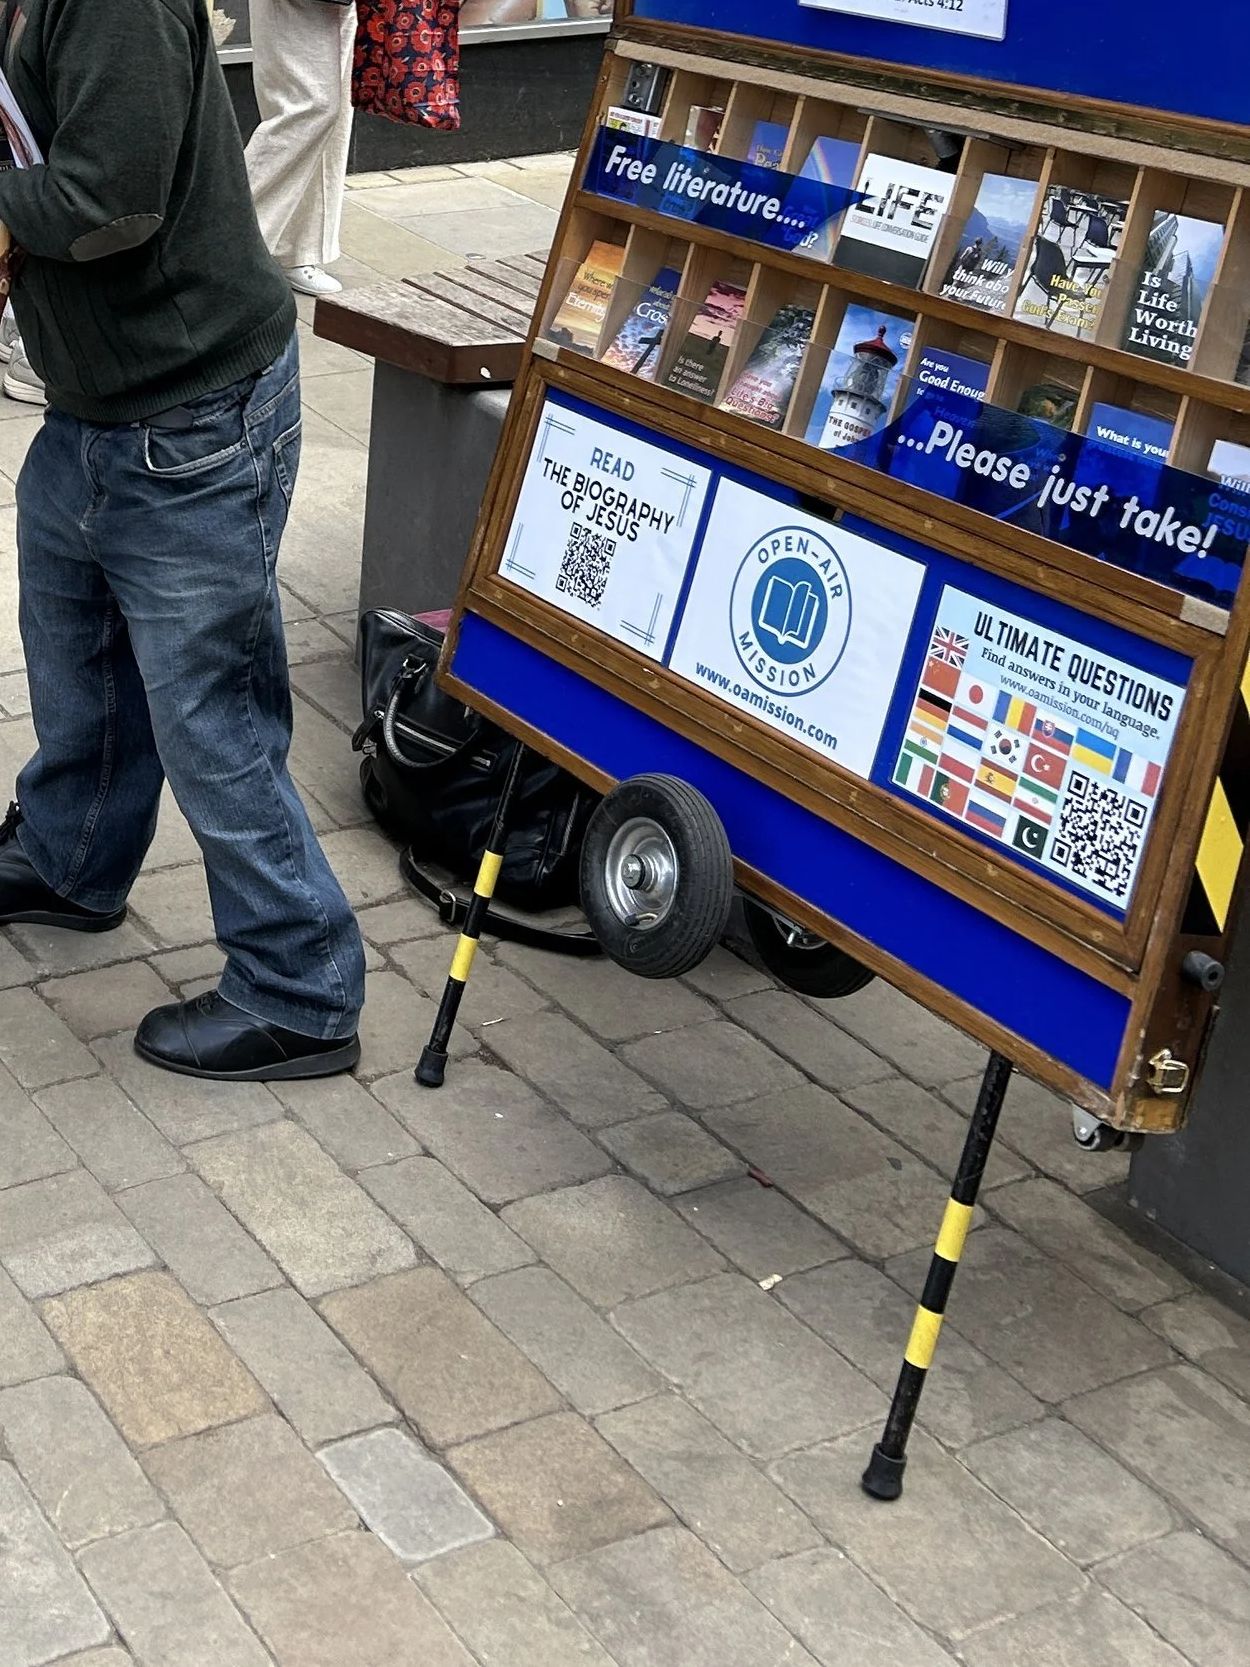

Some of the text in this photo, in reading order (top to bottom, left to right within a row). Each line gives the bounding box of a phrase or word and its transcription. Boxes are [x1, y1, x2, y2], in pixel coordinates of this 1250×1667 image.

[605, 145, 657, 185] Free
[855, 178, 945, 231] LIFE
[584, 270, 608, 288] Where
[952, 268, 982, 289] think
[981, 259, 1006, 276] Will
[1141, 270, 1161, 288] Is
[577, 284, 594, 298] you
[939, 283, 970, 299] your
[1051, 274, 1079, 292] Have
[565, 291, 607, 323] Eternity
[1137, 289, 1178, 313] Life
[1135, 308, 1198, 338] Worth
[1128, 327, 1193, 361] Living
[672, 366, 708, 383] an answer
[684, 358, 705, 372] there
[920, 358, 949, 374] Are you
[668, 374, 677, 382] to
[919, 370, 950, 390] Good
[757, 397, 775, 412] Big
[829, 416, 842, 427] THE
[1097, 426, 1129, 446] What
[1131, 437, 1141, 449] is
[590, 446, 635, 482] READ
[543, 457, 675, 534] THE BIOGRAPHY
[561, 490, 640, 542] OF JESUS
[1036, 464, 1109, 517] just
[1120, 495, 1218, 559] take!
[757, 535, 843, 600] OPEN-AIR
[738, 630, 817, 687] MISSION
[974, 611, 1174, 722] ULTIMATE QUESTIONS
[981, 646, 1160, 740] Find answers in your language.
[695, 661, 838, 750] www.oamission.com
[999, 674, 1120, 741] www.oamission.com/uq
